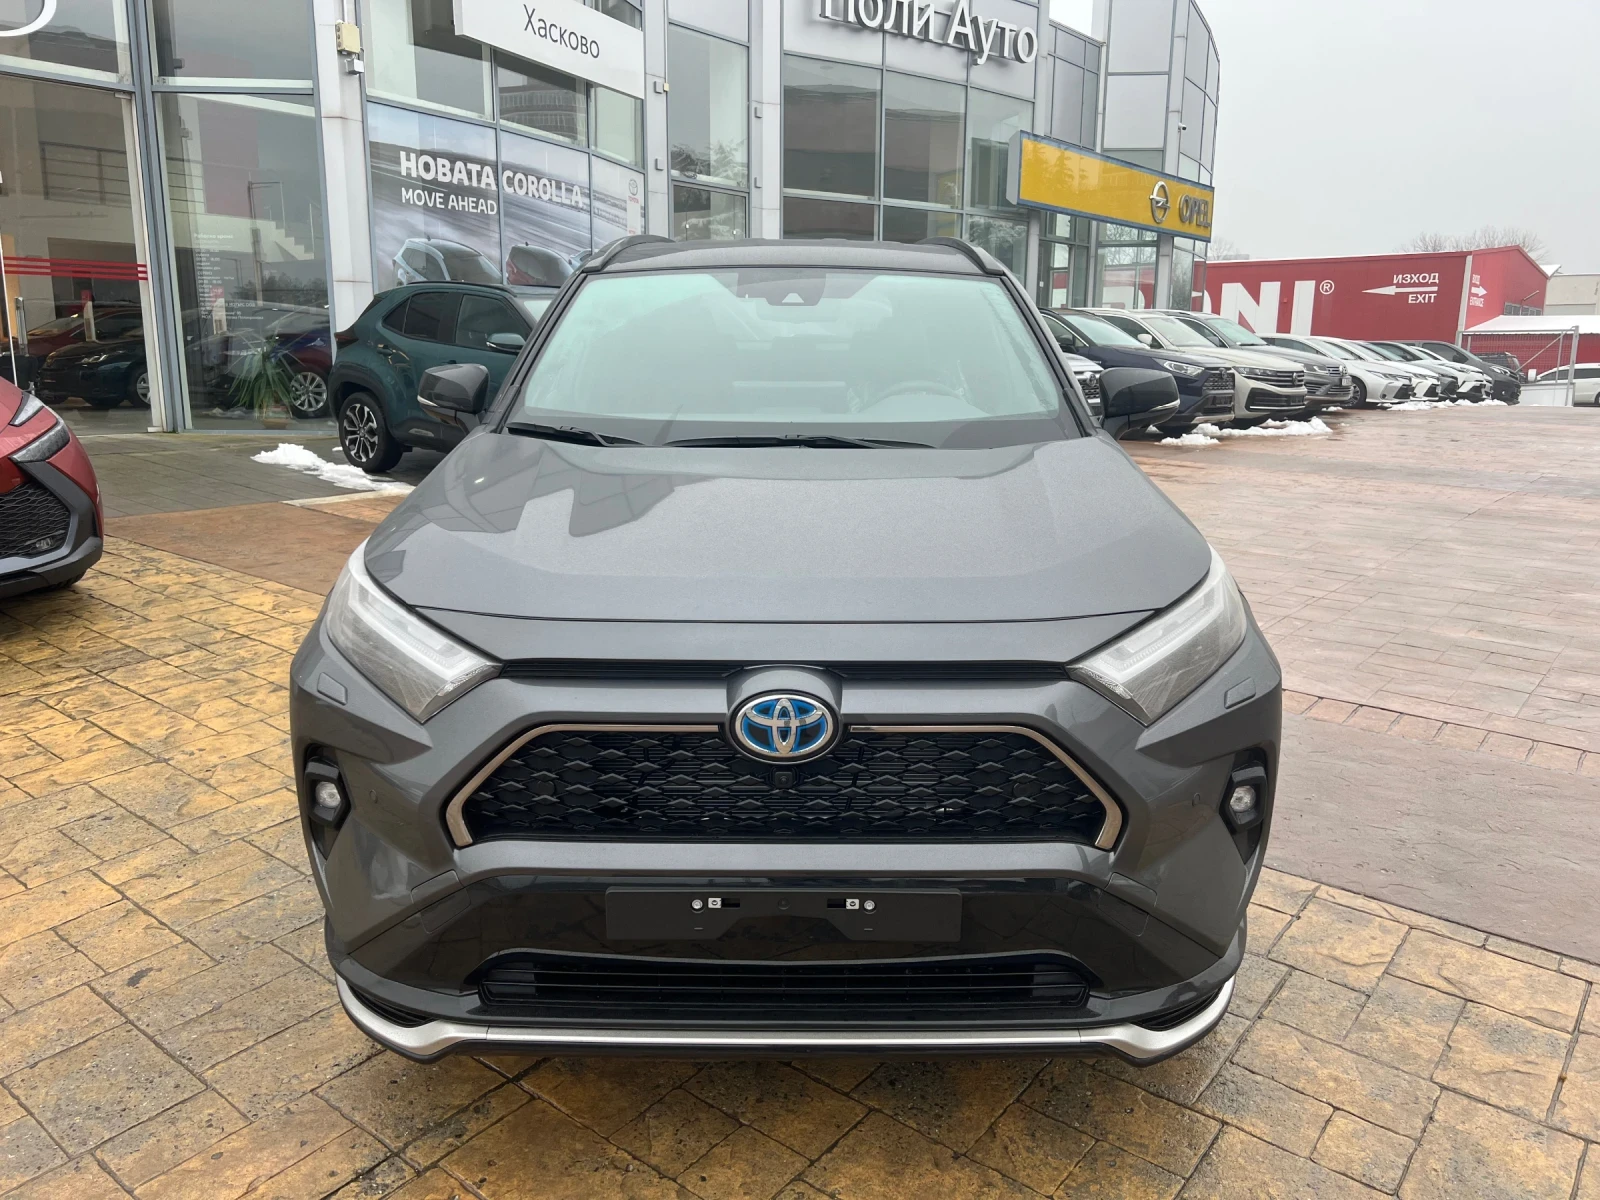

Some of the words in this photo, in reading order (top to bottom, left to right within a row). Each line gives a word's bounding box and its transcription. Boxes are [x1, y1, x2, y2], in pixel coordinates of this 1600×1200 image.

[523, 3, 600, 59] Хасково
[943, 0, 1038, 65] Ауто
[400, 150, 497, 191] НОВАТА
[502, 169, 583, 208] COROLLA
[401, 187, 445, 209] MOVE
[447, 194, 498, 215] AHEAD
[1179, 194, 1211, 228] OPEL
[1393, 273, 1439, 284] ИЗХОД
[1408, 293, 1437, 304] EXIT
